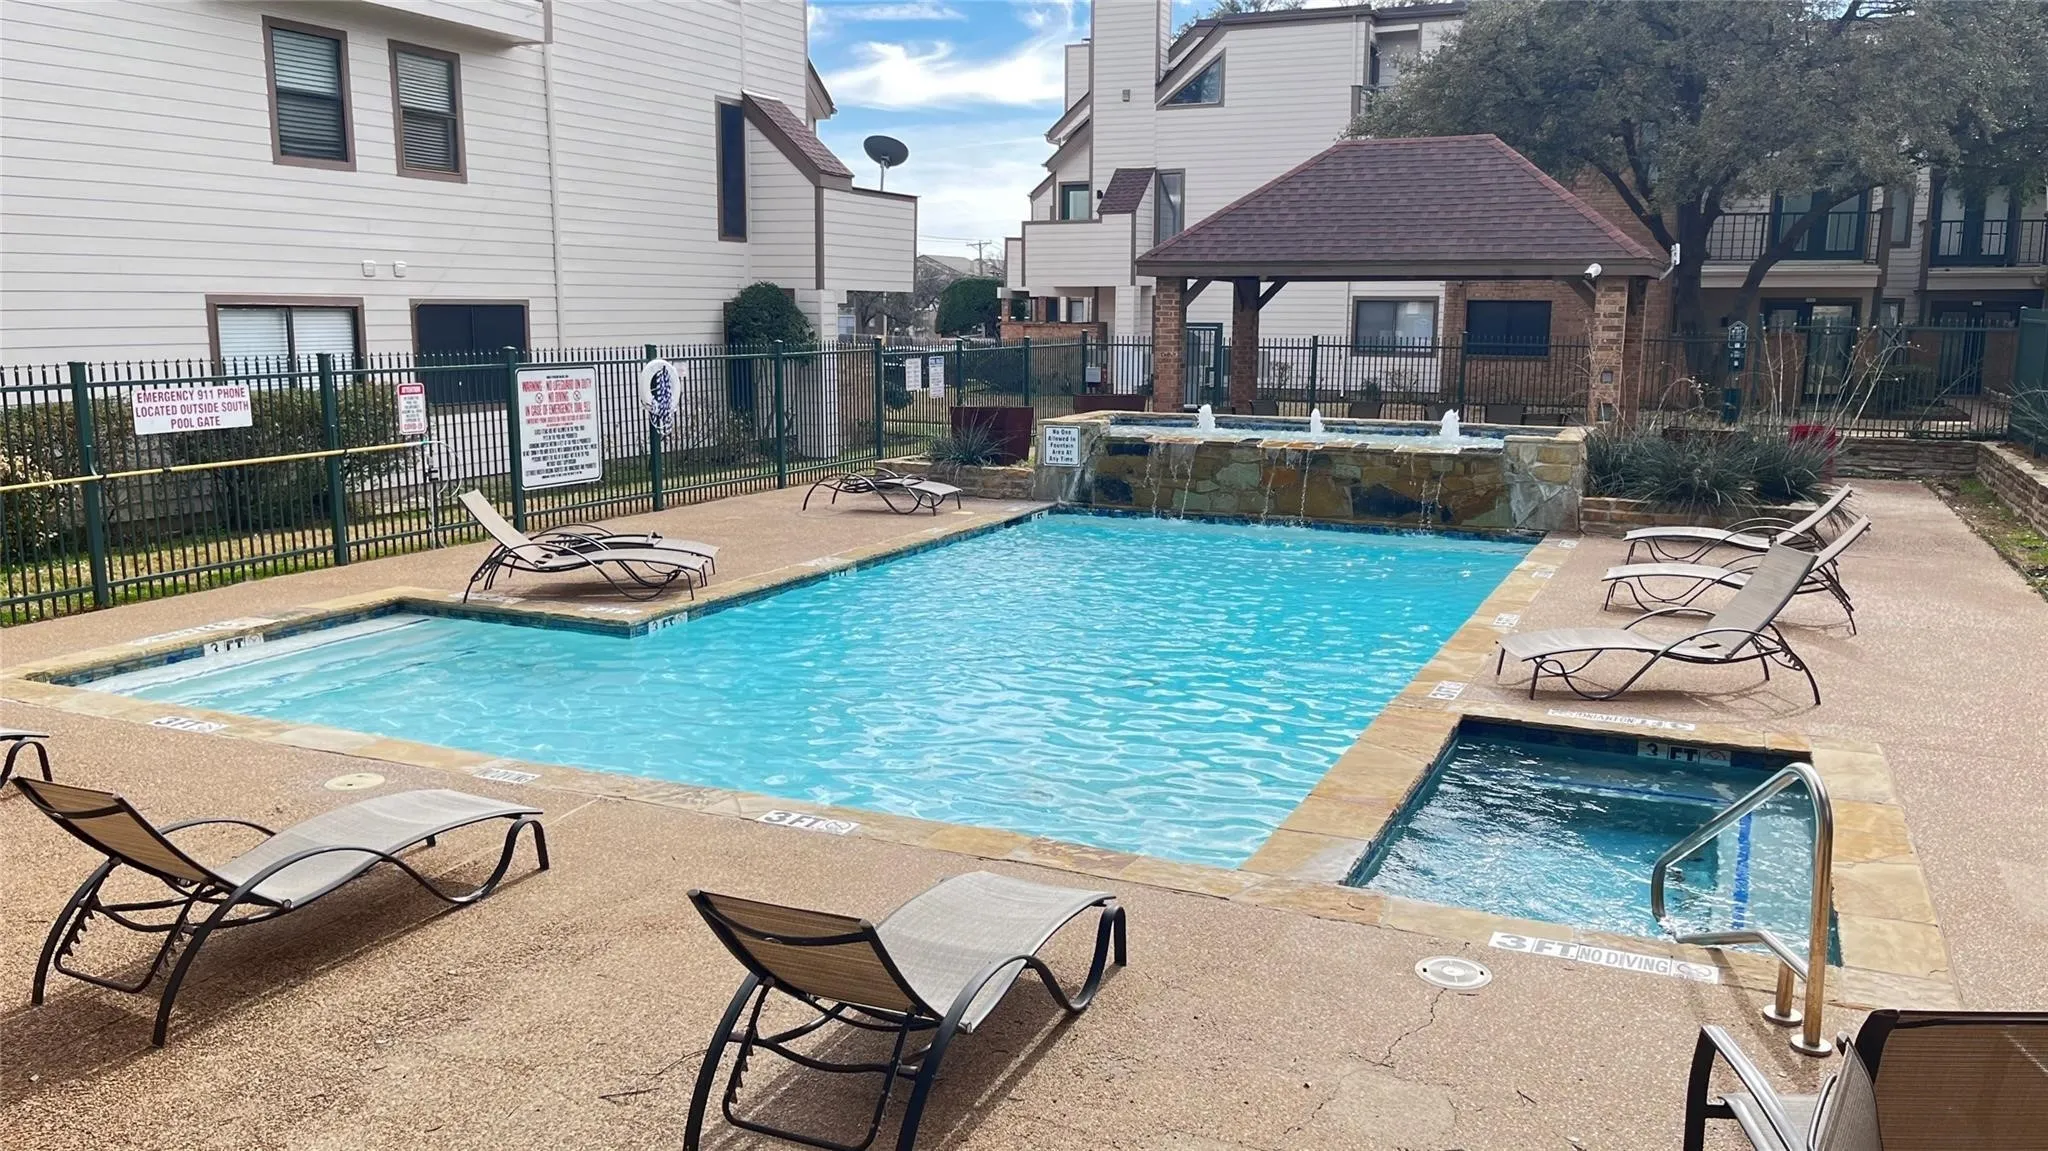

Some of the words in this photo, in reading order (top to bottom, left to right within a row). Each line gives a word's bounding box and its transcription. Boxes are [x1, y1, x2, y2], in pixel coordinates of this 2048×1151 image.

[137, 389, 194, 403] EMERGENCY
[198, 390, 214, 400] 911
[218, 388, 245, 398] PHONE
[136, 404, 177, 418] LOCATED
[181, 402, 218, 414] OUTSIDE
[222, 400, 248, 412] SOUTH
[170, 418, 194, 429] POOL
[197, 416, 220, 428] GATE
[227, 638, 243, 651] FT
[1646, 743, 1658, 756] 3
[1670, 747, 1698, 761] FT
[765, 812, 792, 822] 3
[788, 816, 826, 827] FT
[1496, 935, 1527, 949] 3
[1580, 948, 1602, 961] NO
[1606, 952, 1668, 973] DIVING
